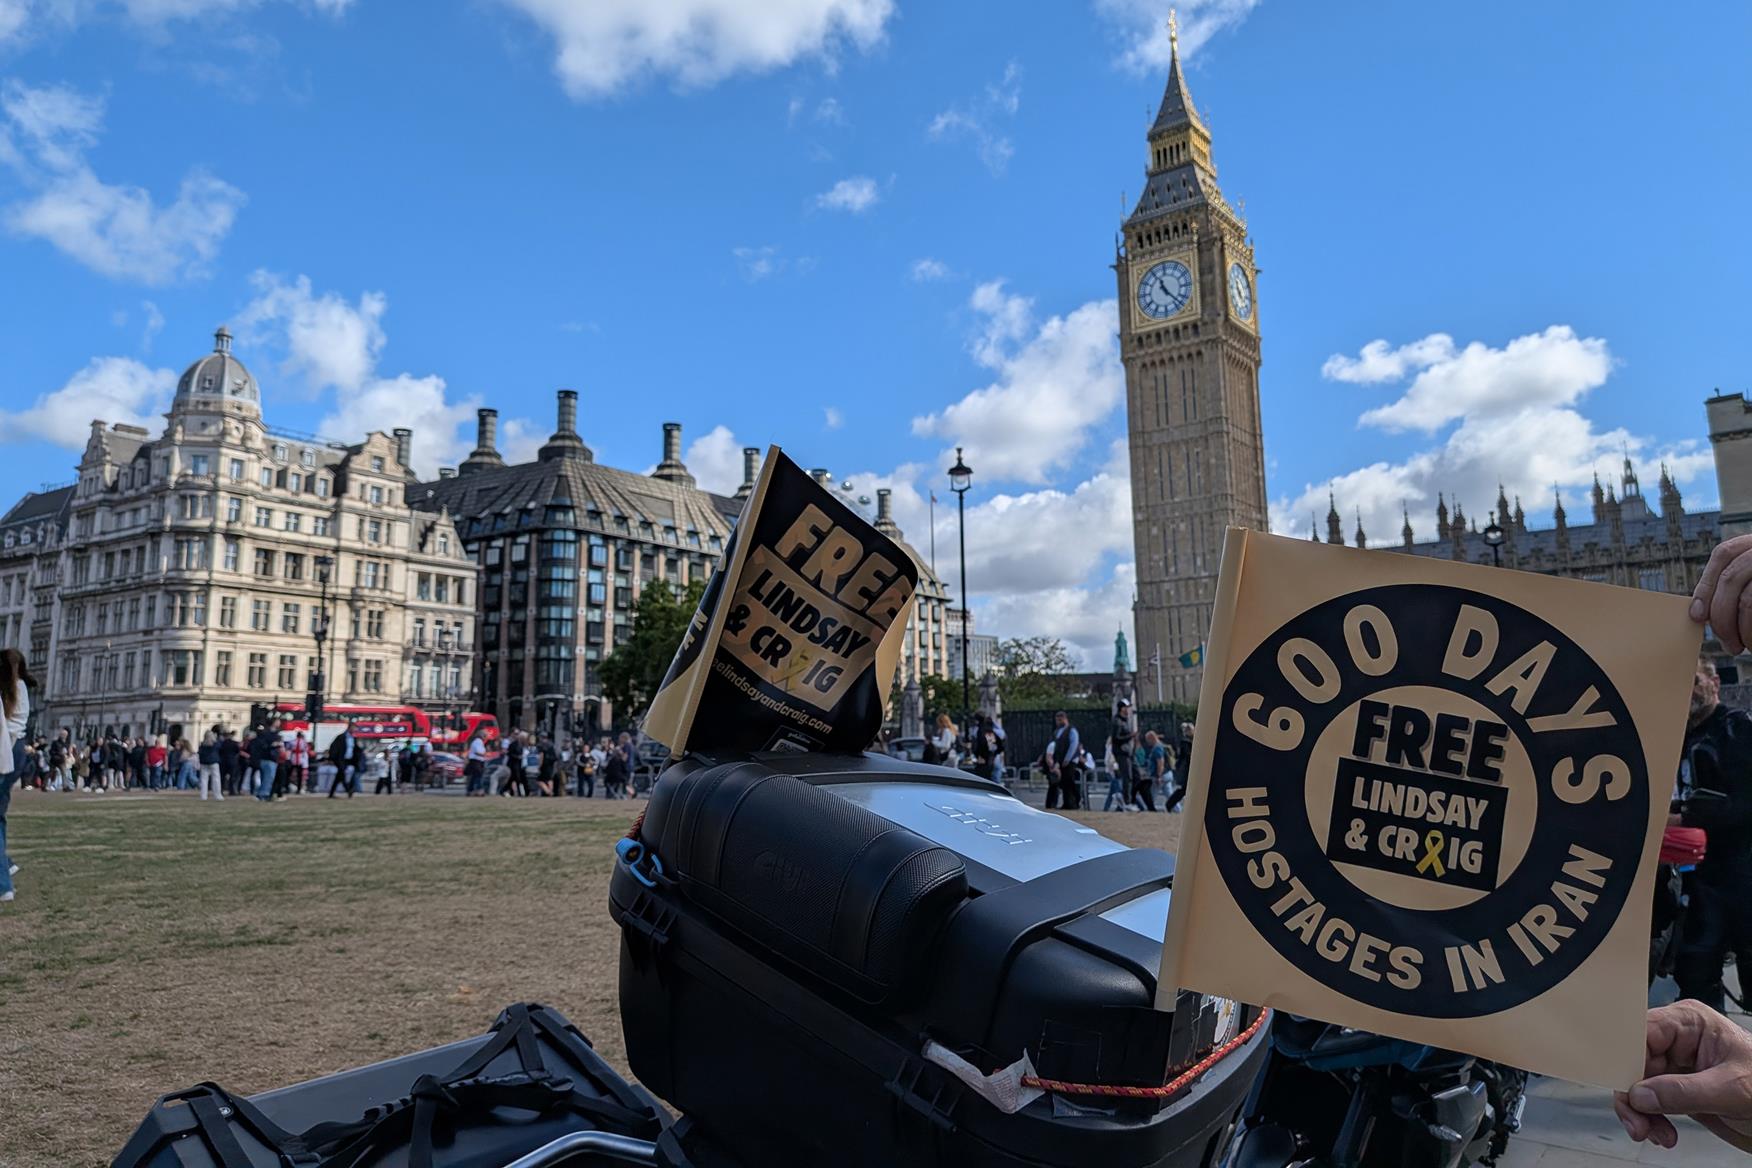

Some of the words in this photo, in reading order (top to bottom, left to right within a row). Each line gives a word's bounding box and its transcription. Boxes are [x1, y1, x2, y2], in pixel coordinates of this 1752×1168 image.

[725, 604, 751, 637] &
[747, 569, 870, 660] LINDSAY
[1231, 604, 1399, 752] 600
[1441, 604, 1632, 804] DAYS
[1352, 699, 1510, 785] FREE
[1344, 818, 1369, 852] &
[1351, 776, 1489, 831] LINDSAY
[1225, 786, 1424, 990] HOSTAGES
[1444, 937, 1506, 993] IN
[1506, 844, 1614, 966] IRAN
